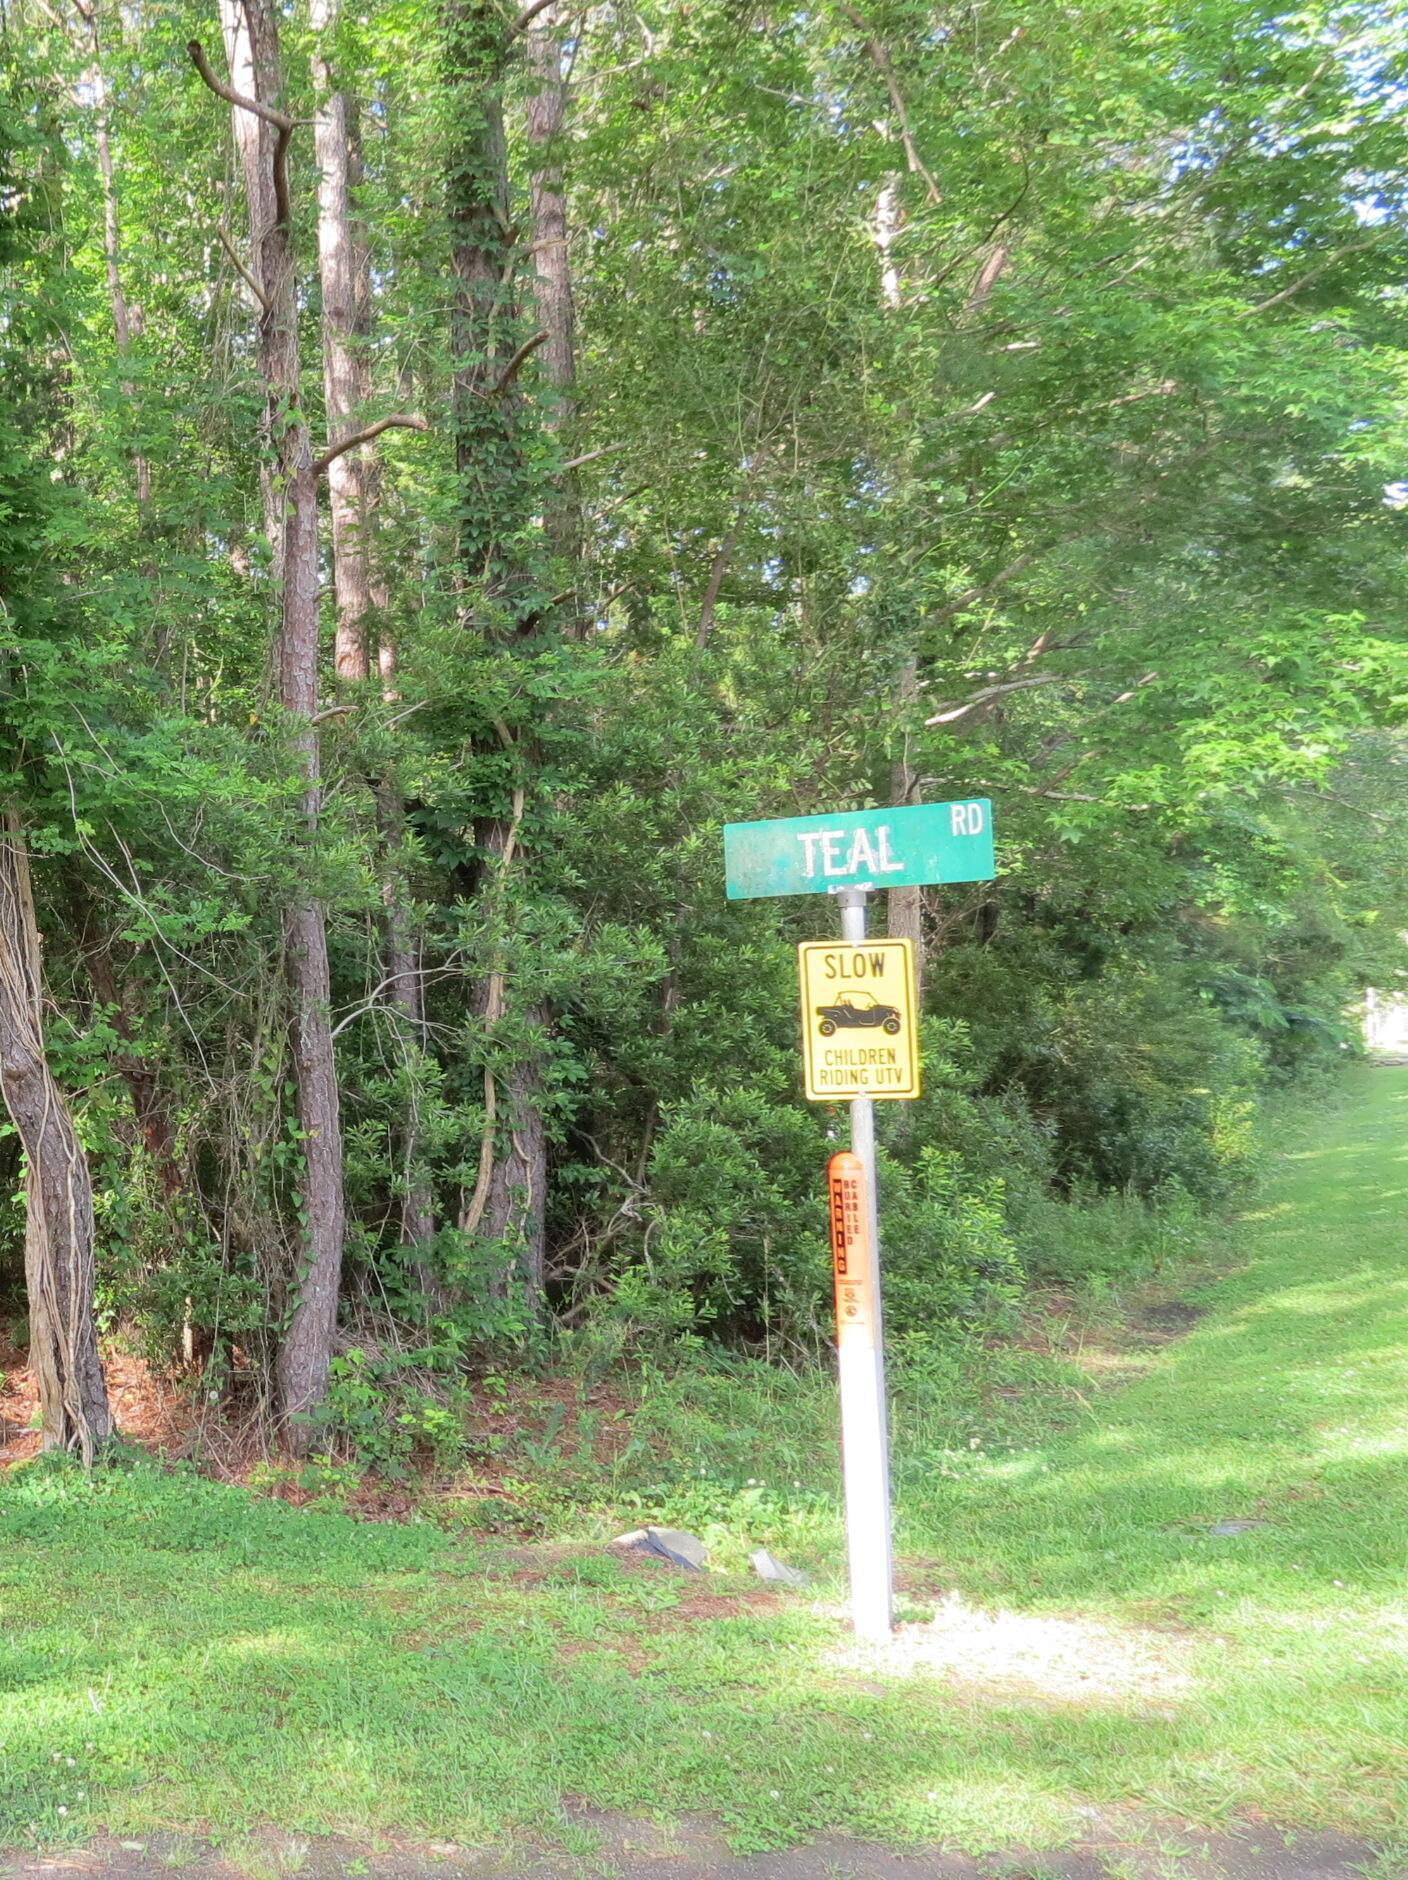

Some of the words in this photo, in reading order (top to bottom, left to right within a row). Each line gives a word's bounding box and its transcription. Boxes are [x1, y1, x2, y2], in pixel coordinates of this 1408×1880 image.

[797, 826, 904, 877] TEAL
[950, 803, 983, 836] RD
[824, 952, 885, 979] SLOW
[820, 1068, 869, 1086] RIDING
[875, 1067, 903, 1085] UTV
[824, 1048, 896, 1066] CHILDREN
[843, 1180, 854, 1245] BURIED
[851, 1180, 860, 1234] CABLE
